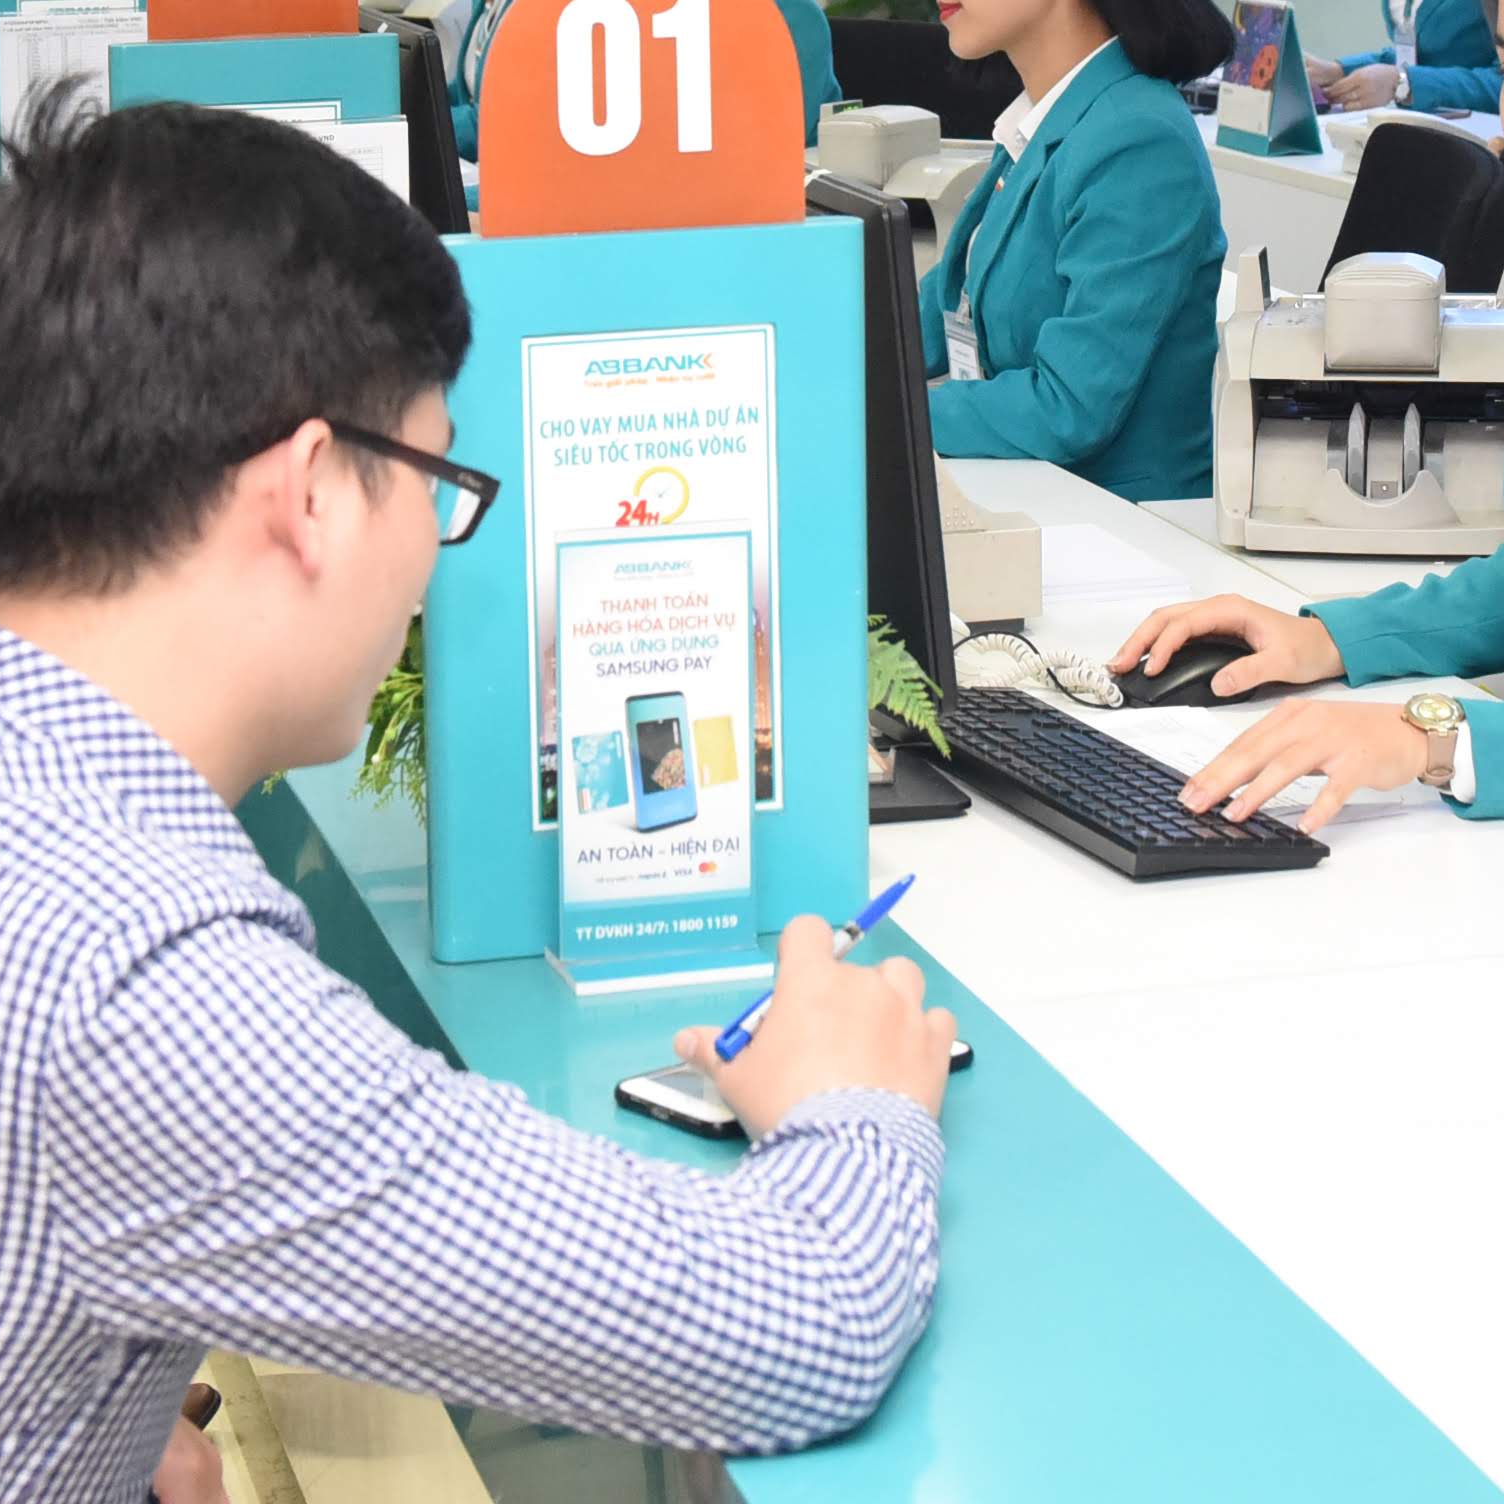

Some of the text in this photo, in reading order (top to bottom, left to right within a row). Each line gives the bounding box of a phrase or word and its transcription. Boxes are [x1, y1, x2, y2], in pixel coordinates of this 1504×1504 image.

[584, 354, 704, 376] ABBANK
[540, 403, 759, 439] CHO VAY MUA NHÀ DỰ ÁN
[554, 434, 747, 467] SIÊU TỐC TRONG VÒNG
[615, 499, 660, 528] 24H
[600, 592, 709, 615] THANH TOÁN
[572, 617, 623, 639] HÀNG
[669, 615, 709, 635] DỊCH
[713, 613, 736, 632] VỤ
[589, 641, 625, 657] QUA
[672, 635, 719, 656] DỤNG
[596, 656, 712, 678] SAMSUNG PAY
[577, 848, 601, 864] AN
[608, 841, 653, 862] TOÀN
[670, 837, 707, 860] HIỆN
[713, 837, 740, 857] ĐẠI
[576, 914, 739, 941] TT DVKH 24/7: 1800 1159
